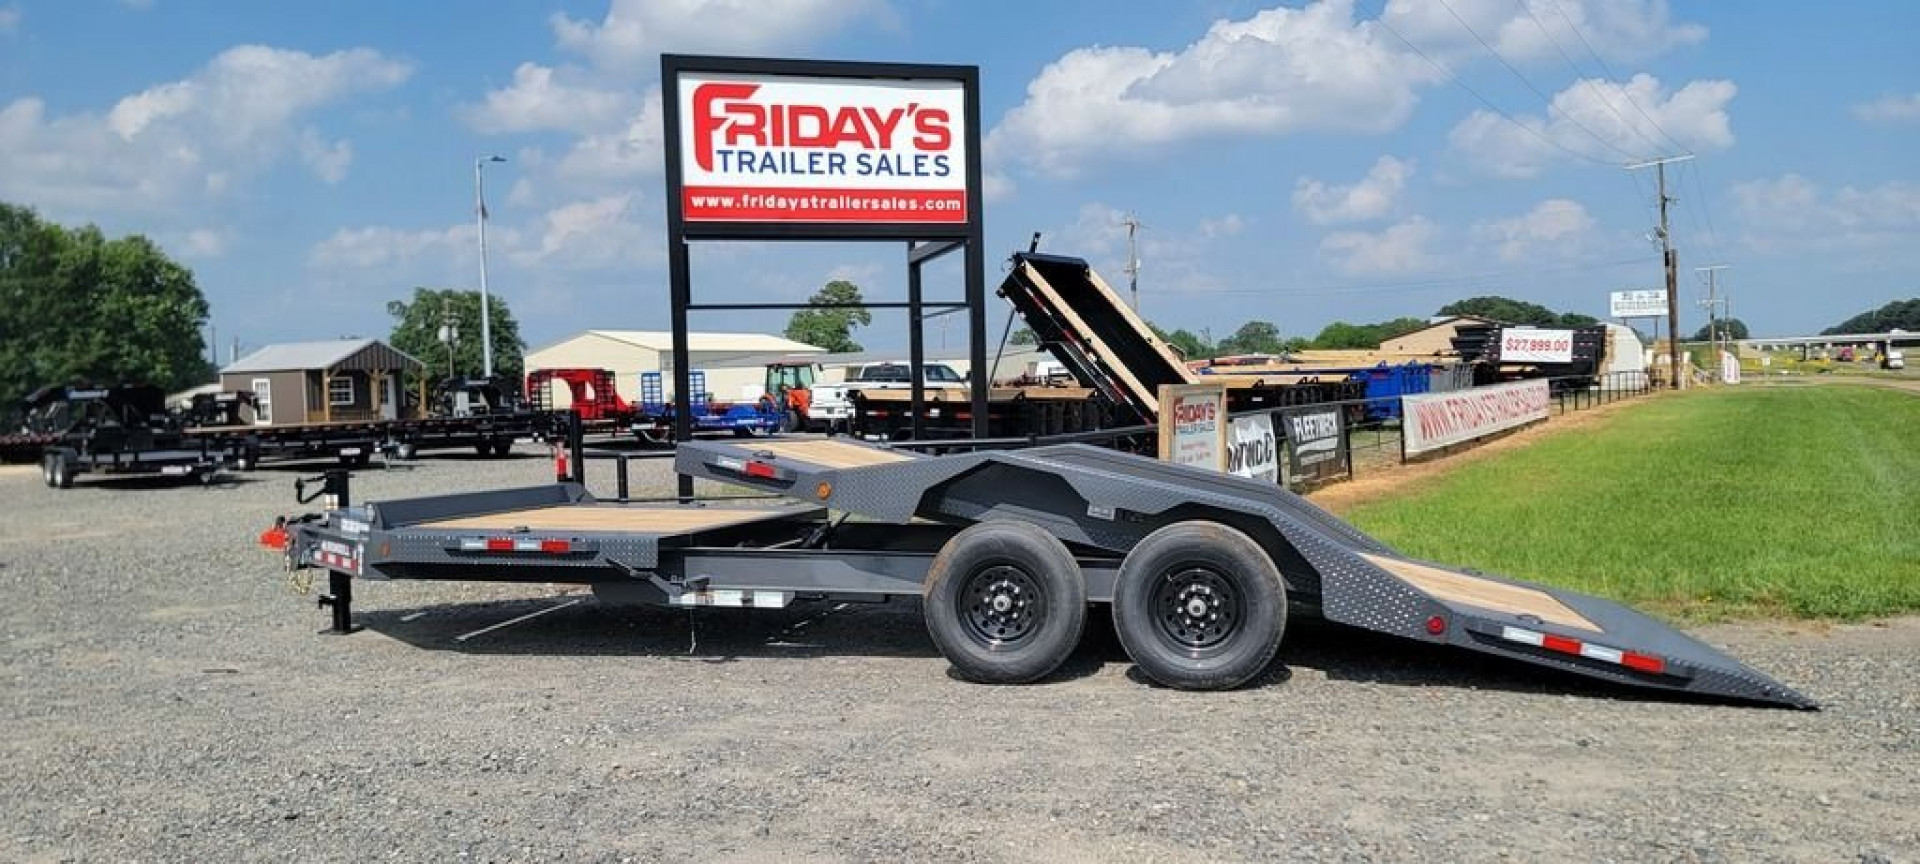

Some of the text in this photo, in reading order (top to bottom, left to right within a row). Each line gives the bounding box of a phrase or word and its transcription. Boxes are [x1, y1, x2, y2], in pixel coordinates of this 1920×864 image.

[692, 83, 952, 173] FRIDAY'S
[717, 149, 951, 177] TRAILER SALES
[690, 194, 962, 211] www.fridaystrailersales.com
